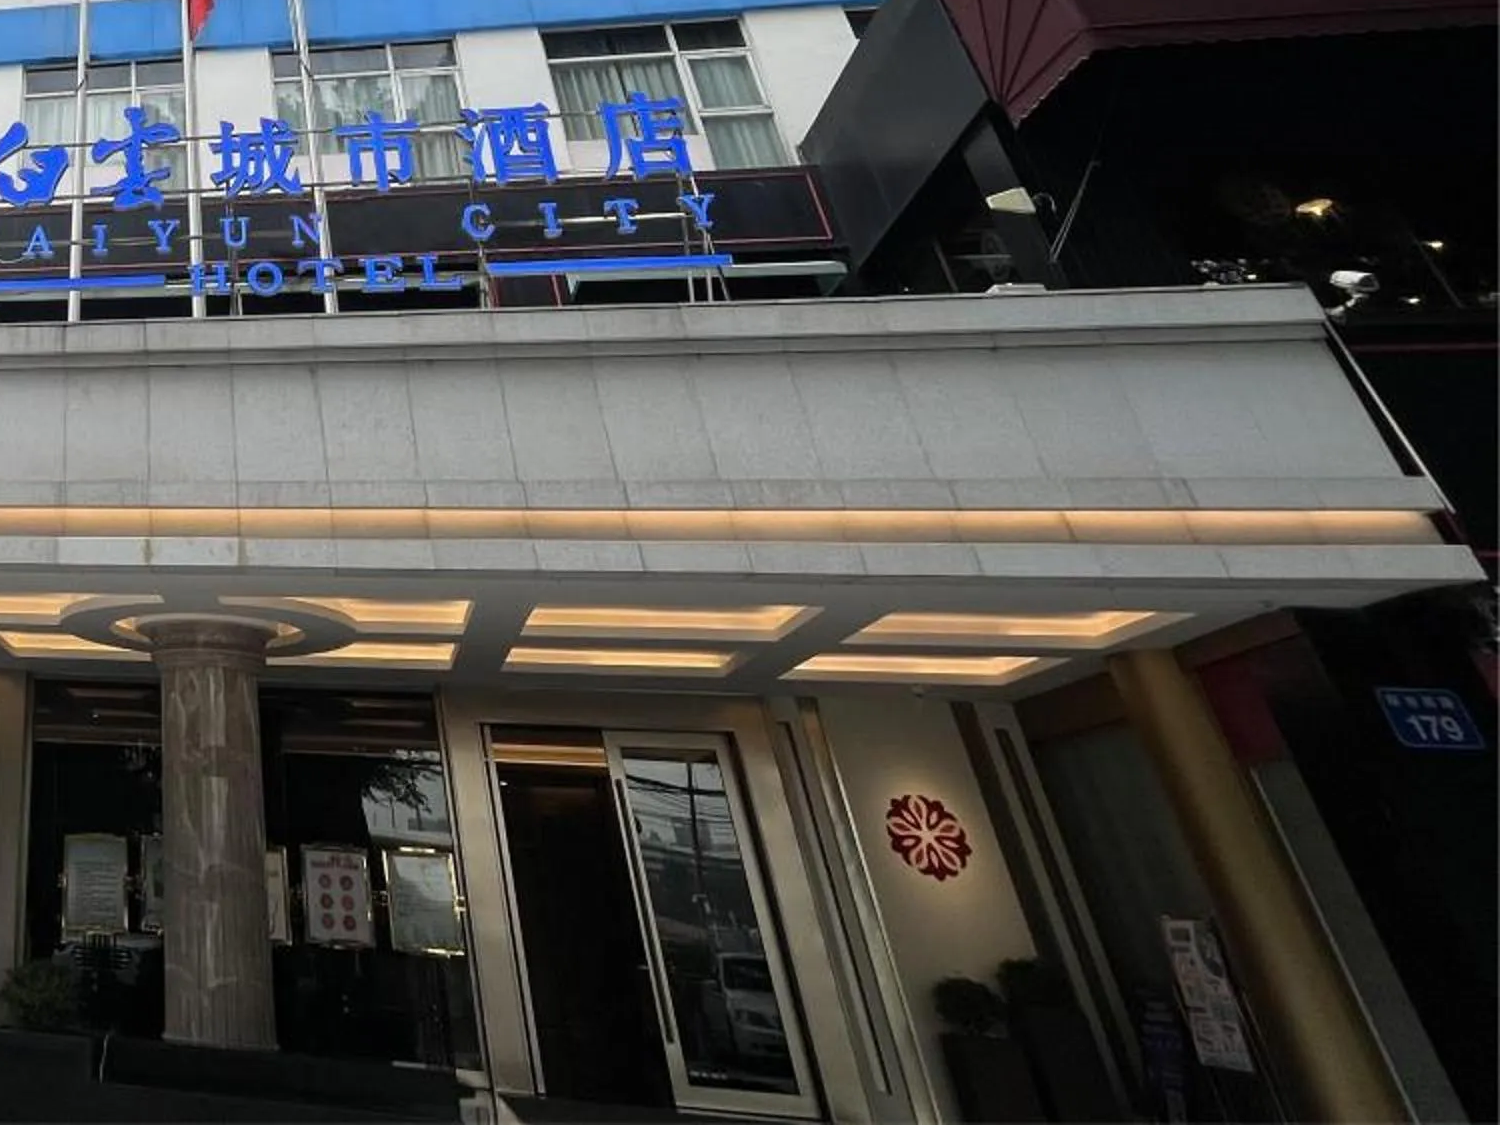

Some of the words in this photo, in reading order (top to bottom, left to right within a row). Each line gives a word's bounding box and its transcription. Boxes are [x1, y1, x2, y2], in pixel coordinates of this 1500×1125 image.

[461, 192, 715, 240] CITY
[190, 254, 462, 297] HOTEL
[1405, 715, 1464, 742] 179
